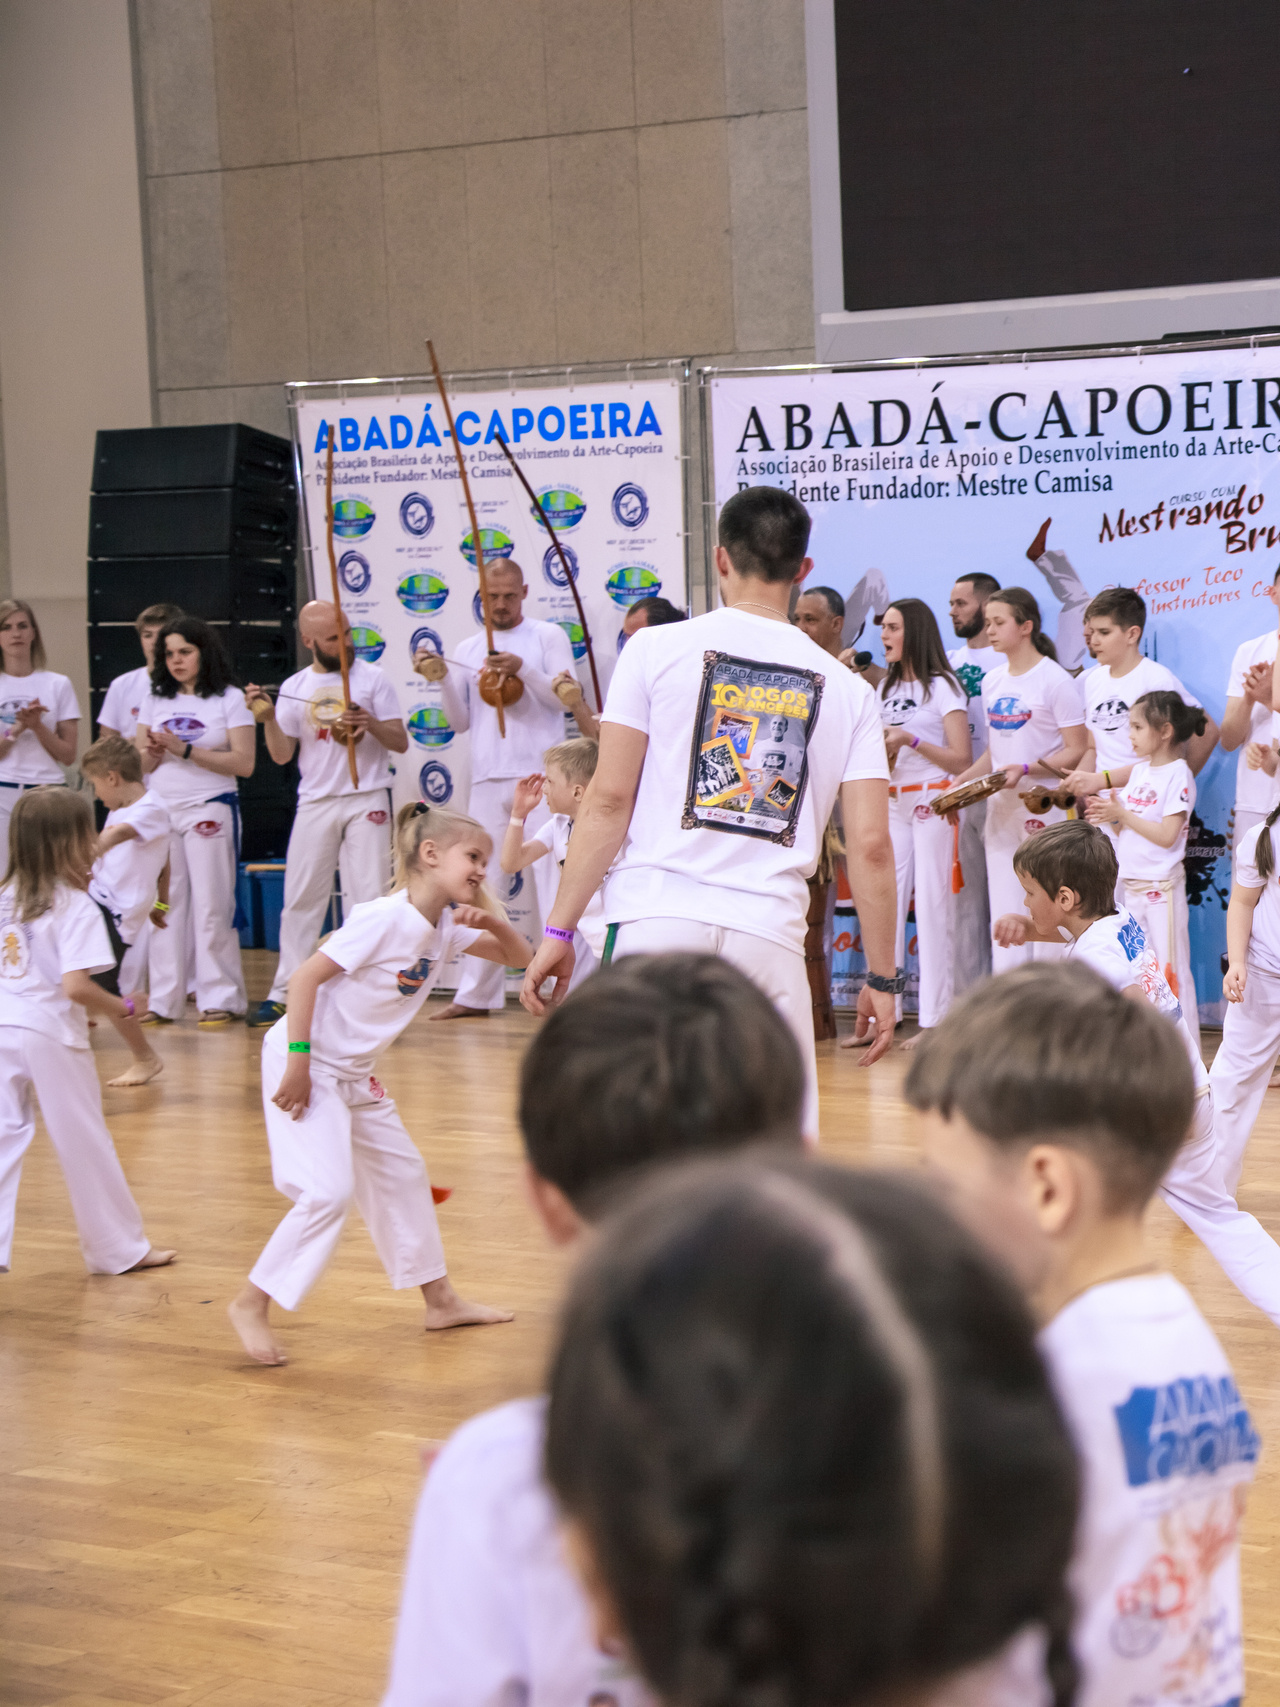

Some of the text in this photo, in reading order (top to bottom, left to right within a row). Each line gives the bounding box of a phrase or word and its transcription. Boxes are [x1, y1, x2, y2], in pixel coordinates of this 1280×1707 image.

[314, 400, 662, 453] ABADÁ-CAPOEIRA
[371, 452, 418, 467] Brasileira
[421, 453, 432, 465] de
[469, 452, 476, 462] e
[573, 445, 586, 457] da
[588, 442, 663, 458] Arte-Capoeira
[737, 454, 827, 478] Associação
[832, 451, 913, 472] Brasileira
[919, 449, 940, 469] de
[945, 446, 998, 474] Apoio
[1004, 450, 1013, 465] e
[1018, 440, 1180, 465] Desenvolvimento
[1185, 436, 1207, 457] da
[737, 467, 1113, 503] Pdente Fundador: Mestre Camisa
[1169, 485, 1236, 506] CURSO COM
[1098, 484, 1265, 544] Mestrando
[1203, 565, 1243, 588] Teco
[1151, 588, 1241, 615] Instrutores
